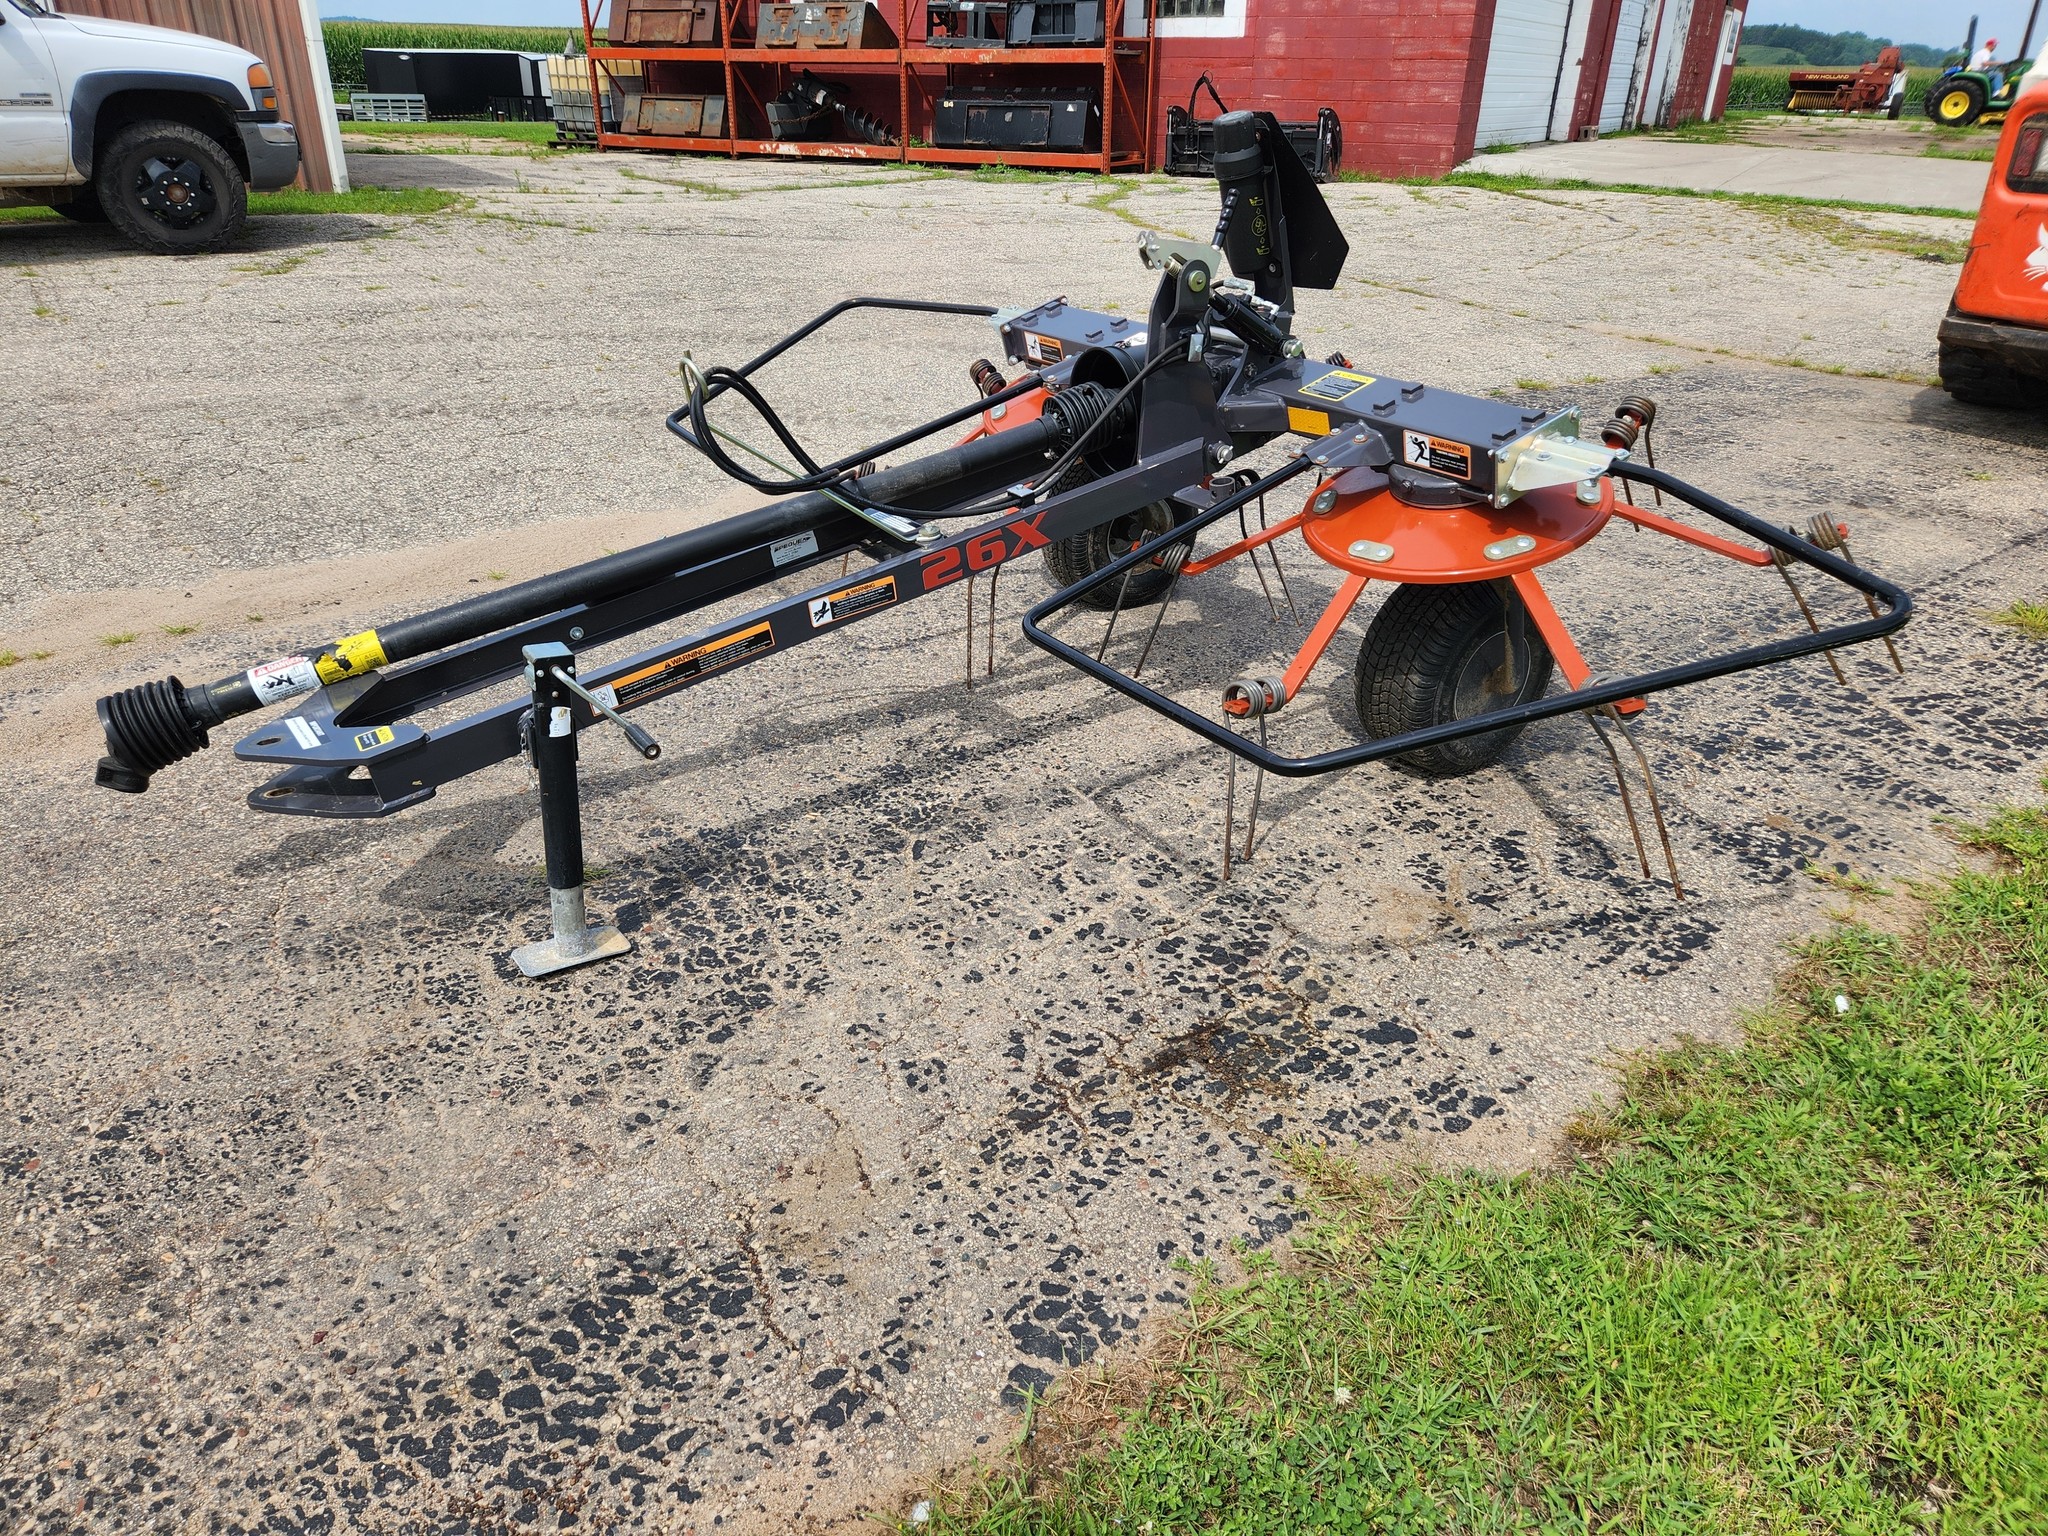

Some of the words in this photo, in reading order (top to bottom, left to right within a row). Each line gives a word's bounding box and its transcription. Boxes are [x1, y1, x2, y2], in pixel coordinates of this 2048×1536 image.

[1437, 441, 1465, 454] WARNING
[920, 510, 1052, 590] 26X
[850, 583, 876, 594] WARNING
[268, 657, 303, 671] DANGER
[671, 648, 707, 666] WARNING
